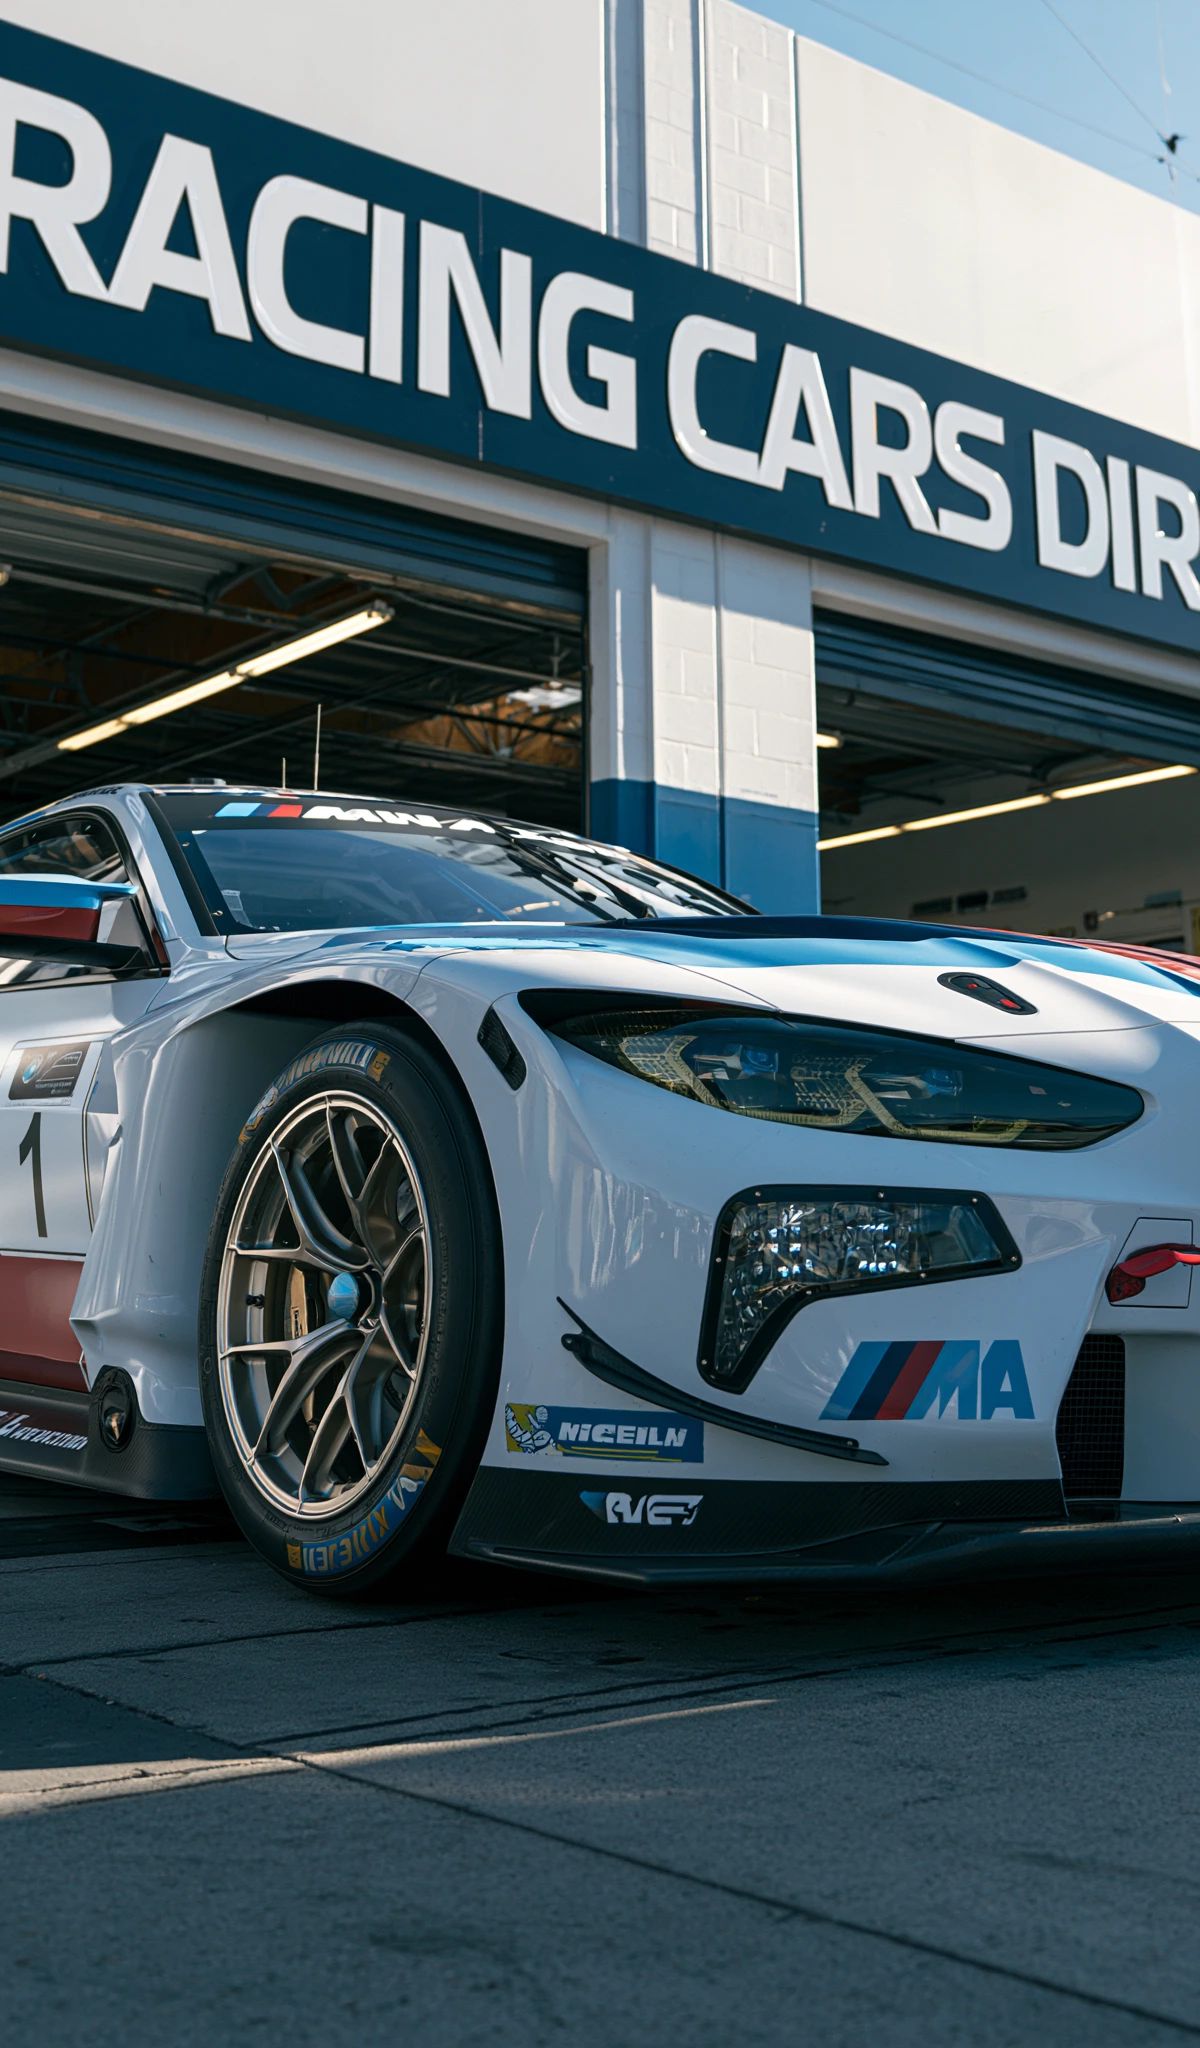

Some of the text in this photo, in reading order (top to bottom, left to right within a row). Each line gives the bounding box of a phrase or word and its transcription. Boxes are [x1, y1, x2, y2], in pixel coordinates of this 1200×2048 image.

[0, 77, 1200, 612] RACING CARS DIR
[19, 1112, 48, 1238] 1
